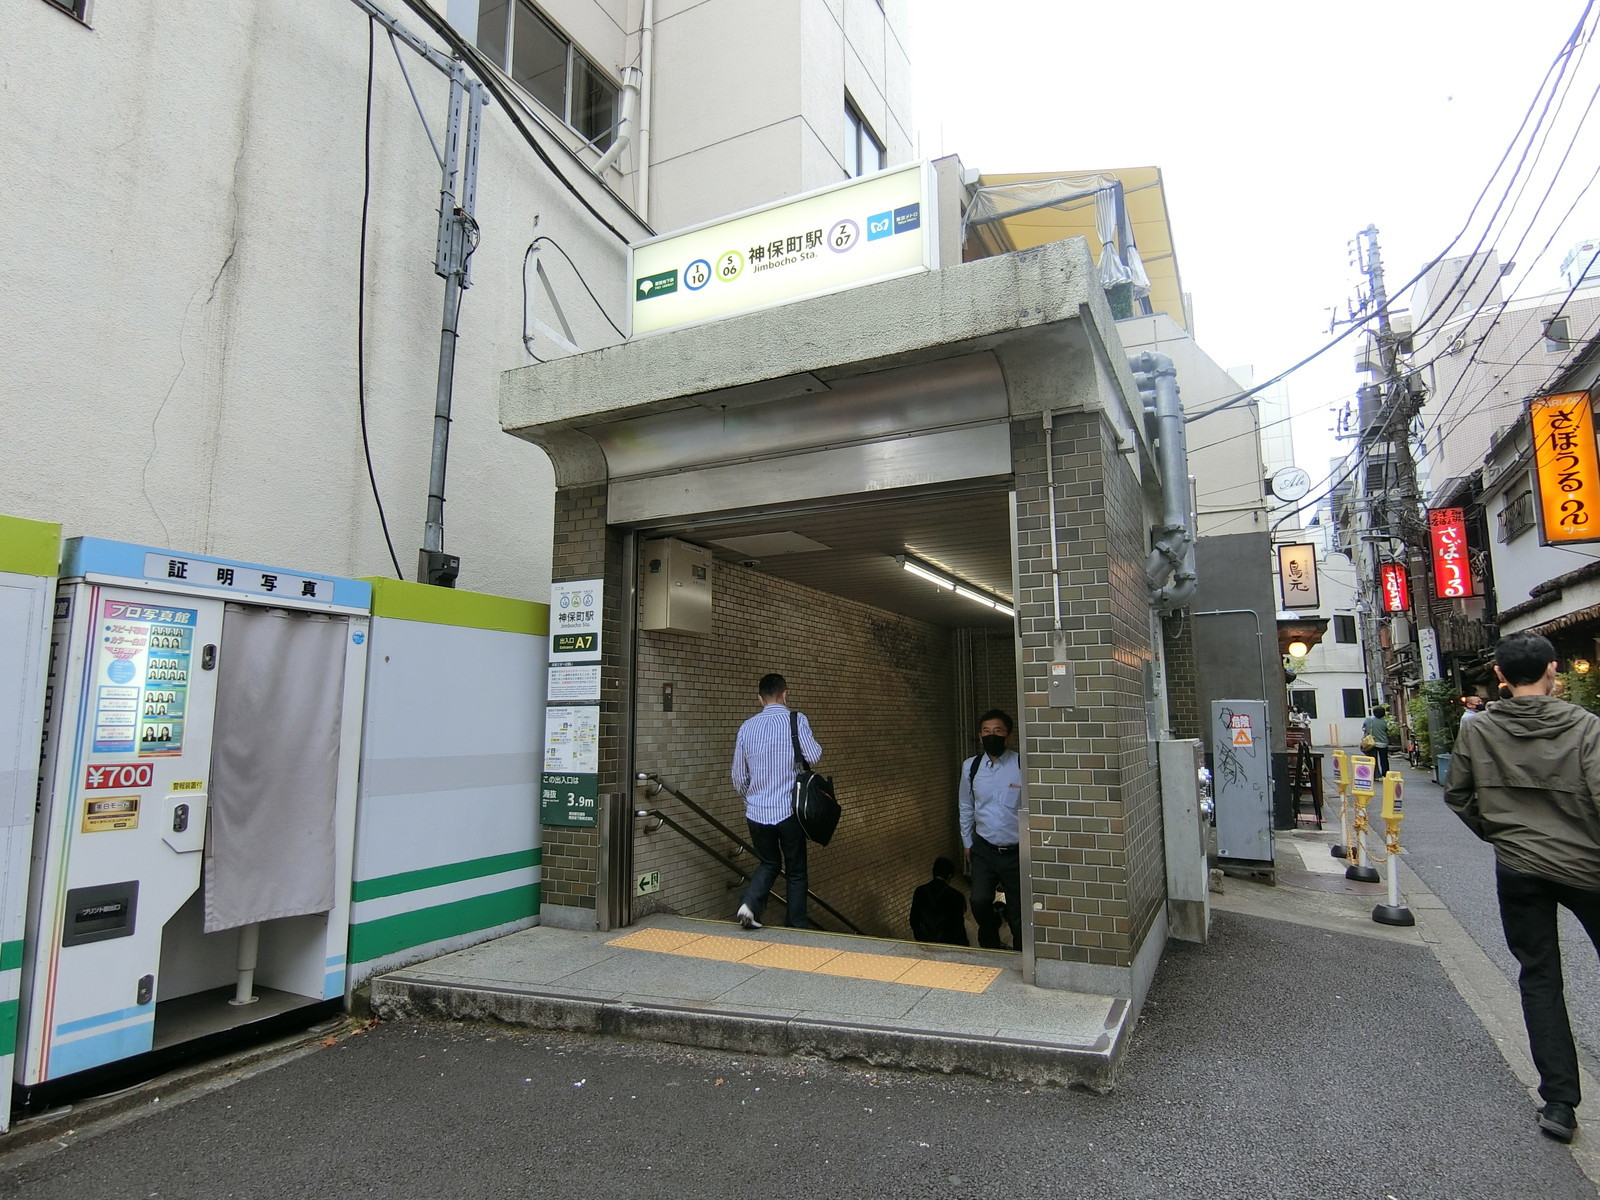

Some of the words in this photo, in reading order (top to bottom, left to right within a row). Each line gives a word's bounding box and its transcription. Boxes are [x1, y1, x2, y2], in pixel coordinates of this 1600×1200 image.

[840, 225, 847, 234] Z
[748, 229, 823, 264] 神保町駅
[835, 234, 851, 247] 07
[727, 256, 733, 265] S
[753, 255, 797, 273] Jimbocho
[800, 251, 818, 262] Sta.
[695, 265, 700, 273] I
[723, 265, 737, 276] 06
[692, 273, 704, 284] 10
[1438, 526, 1464, 597] さぼうる
[168, 559, 318, 599] 証明写真
[111, 604, 192, 624] プロ写真館
[559, 610, 594, 623] 神保町駅
[575, 636, 592, 649] A7
[1231, 716, 1250, 728] 危険
[88, 765, 151, 788] ¥700
[543, 775, 579, 784] この出入口は
[567, 792, 594, 807] 3.9m
